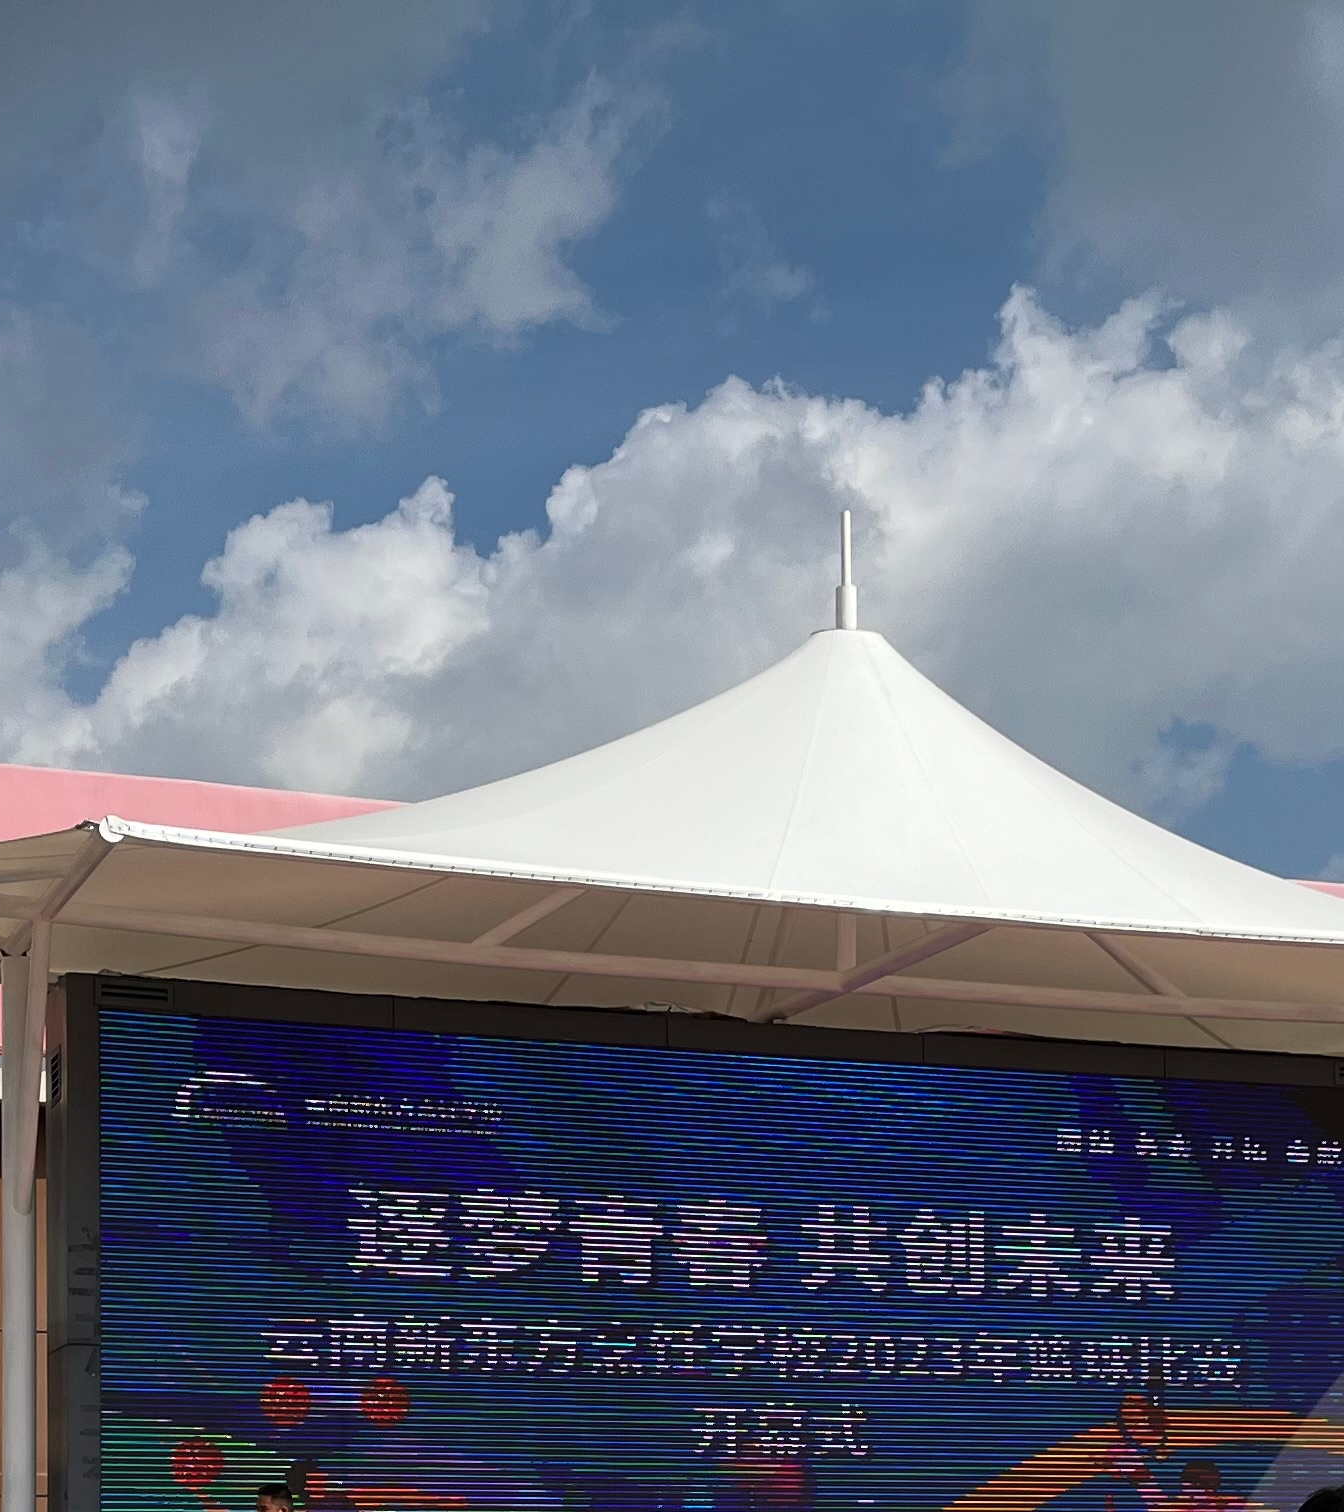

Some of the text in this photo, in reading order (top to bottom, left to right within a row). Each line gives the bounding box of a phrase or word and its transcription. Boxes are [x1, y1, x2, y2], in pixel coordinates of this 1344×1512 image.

[346, 1182, 1179, 1305] 逐梦青春 共创未来
